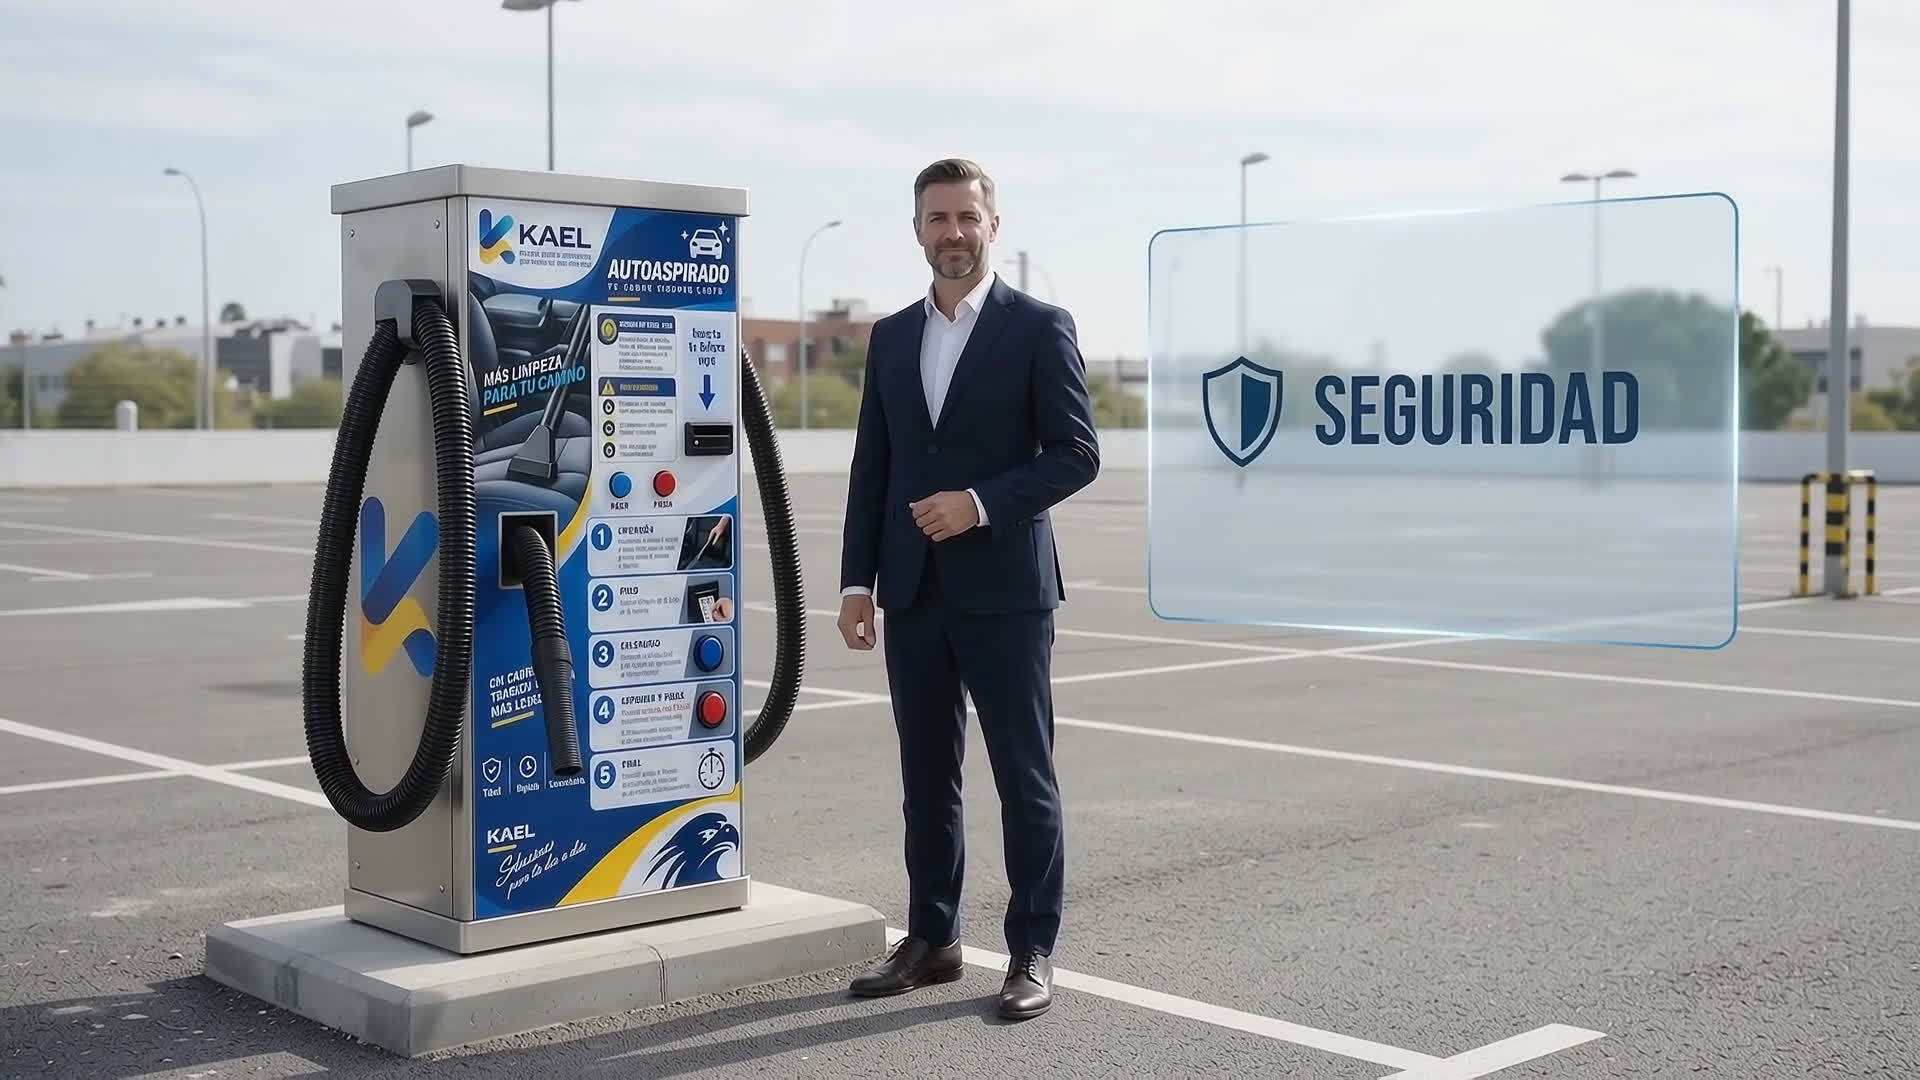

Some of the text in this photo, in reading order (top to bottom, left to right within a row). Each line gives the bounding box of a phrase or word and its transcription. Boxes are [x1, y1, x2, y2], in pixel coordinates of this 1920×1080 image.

[519, 223, 592, 249] KAEL
[607, 258, 730, 284] AUTOASPIRADO
[483, 365, 509, 388] MÁS
[483, 382, 518, 406] PARA
[520, 376, 536, 396] TU
[597, 528, 605, 546] 1
[597, 589, 609, 607] 2
[598, 645, 609, 664] 3
[598, 700, 610, 719] 4
[600, 765, 611, 784] 5
[487, 824, 536, 845] KAEL
